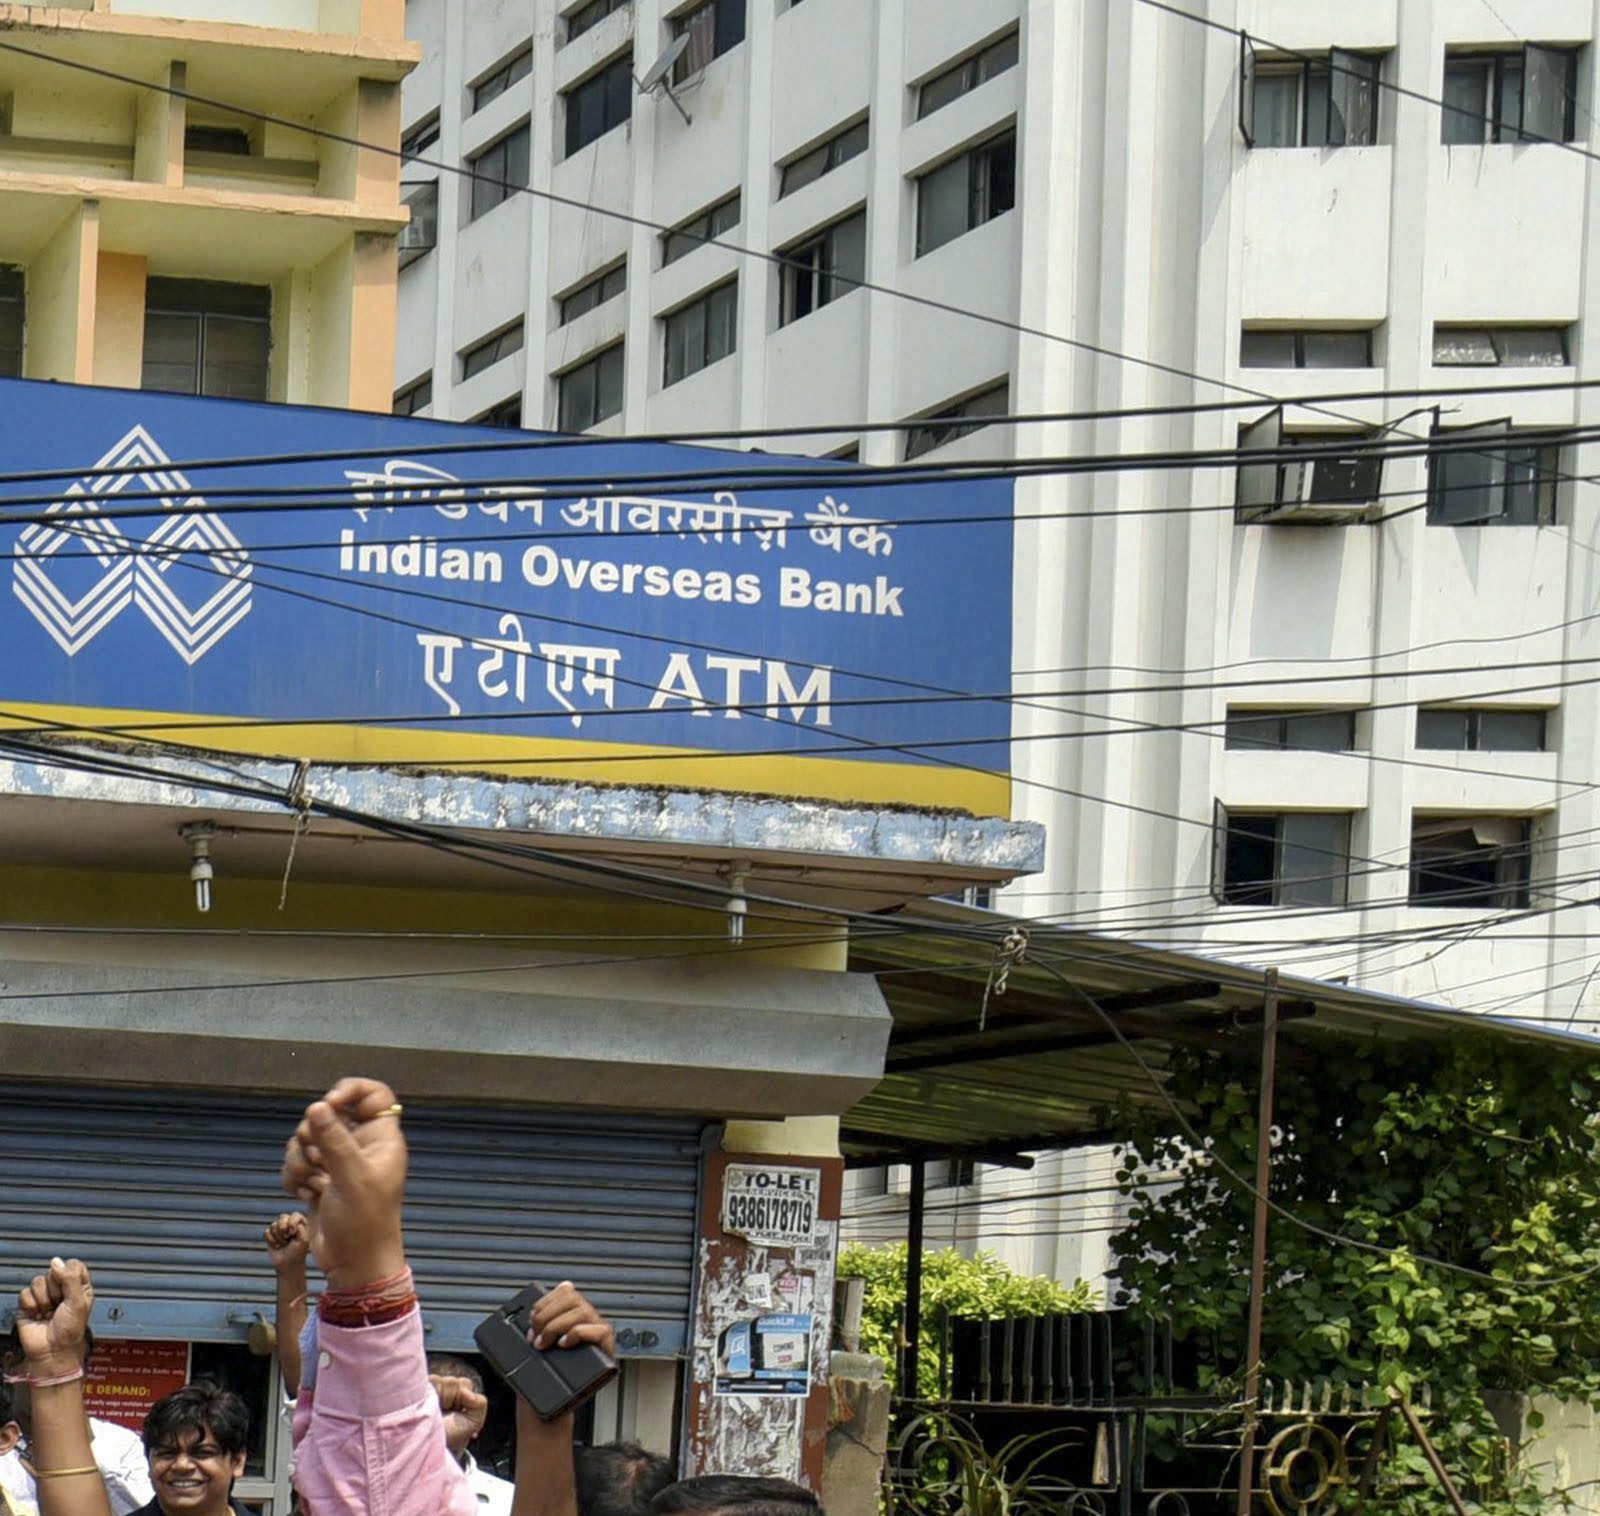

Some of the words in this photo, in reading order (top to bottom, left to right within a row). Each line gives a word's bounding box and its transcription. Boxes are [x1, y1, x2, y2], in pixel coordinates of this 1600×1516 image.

[804, 495, 897, 557] बैंक
[339, 529, 502, 583] Indian
[521, 545, 763, 605] Overseas
[780, 567, 905, 618] Bank
[648, 653, 835, 727] ATM
[729, 1195, 812, 1233] 9386178719
[97, 1385, 151, 1397] DEMAND:
